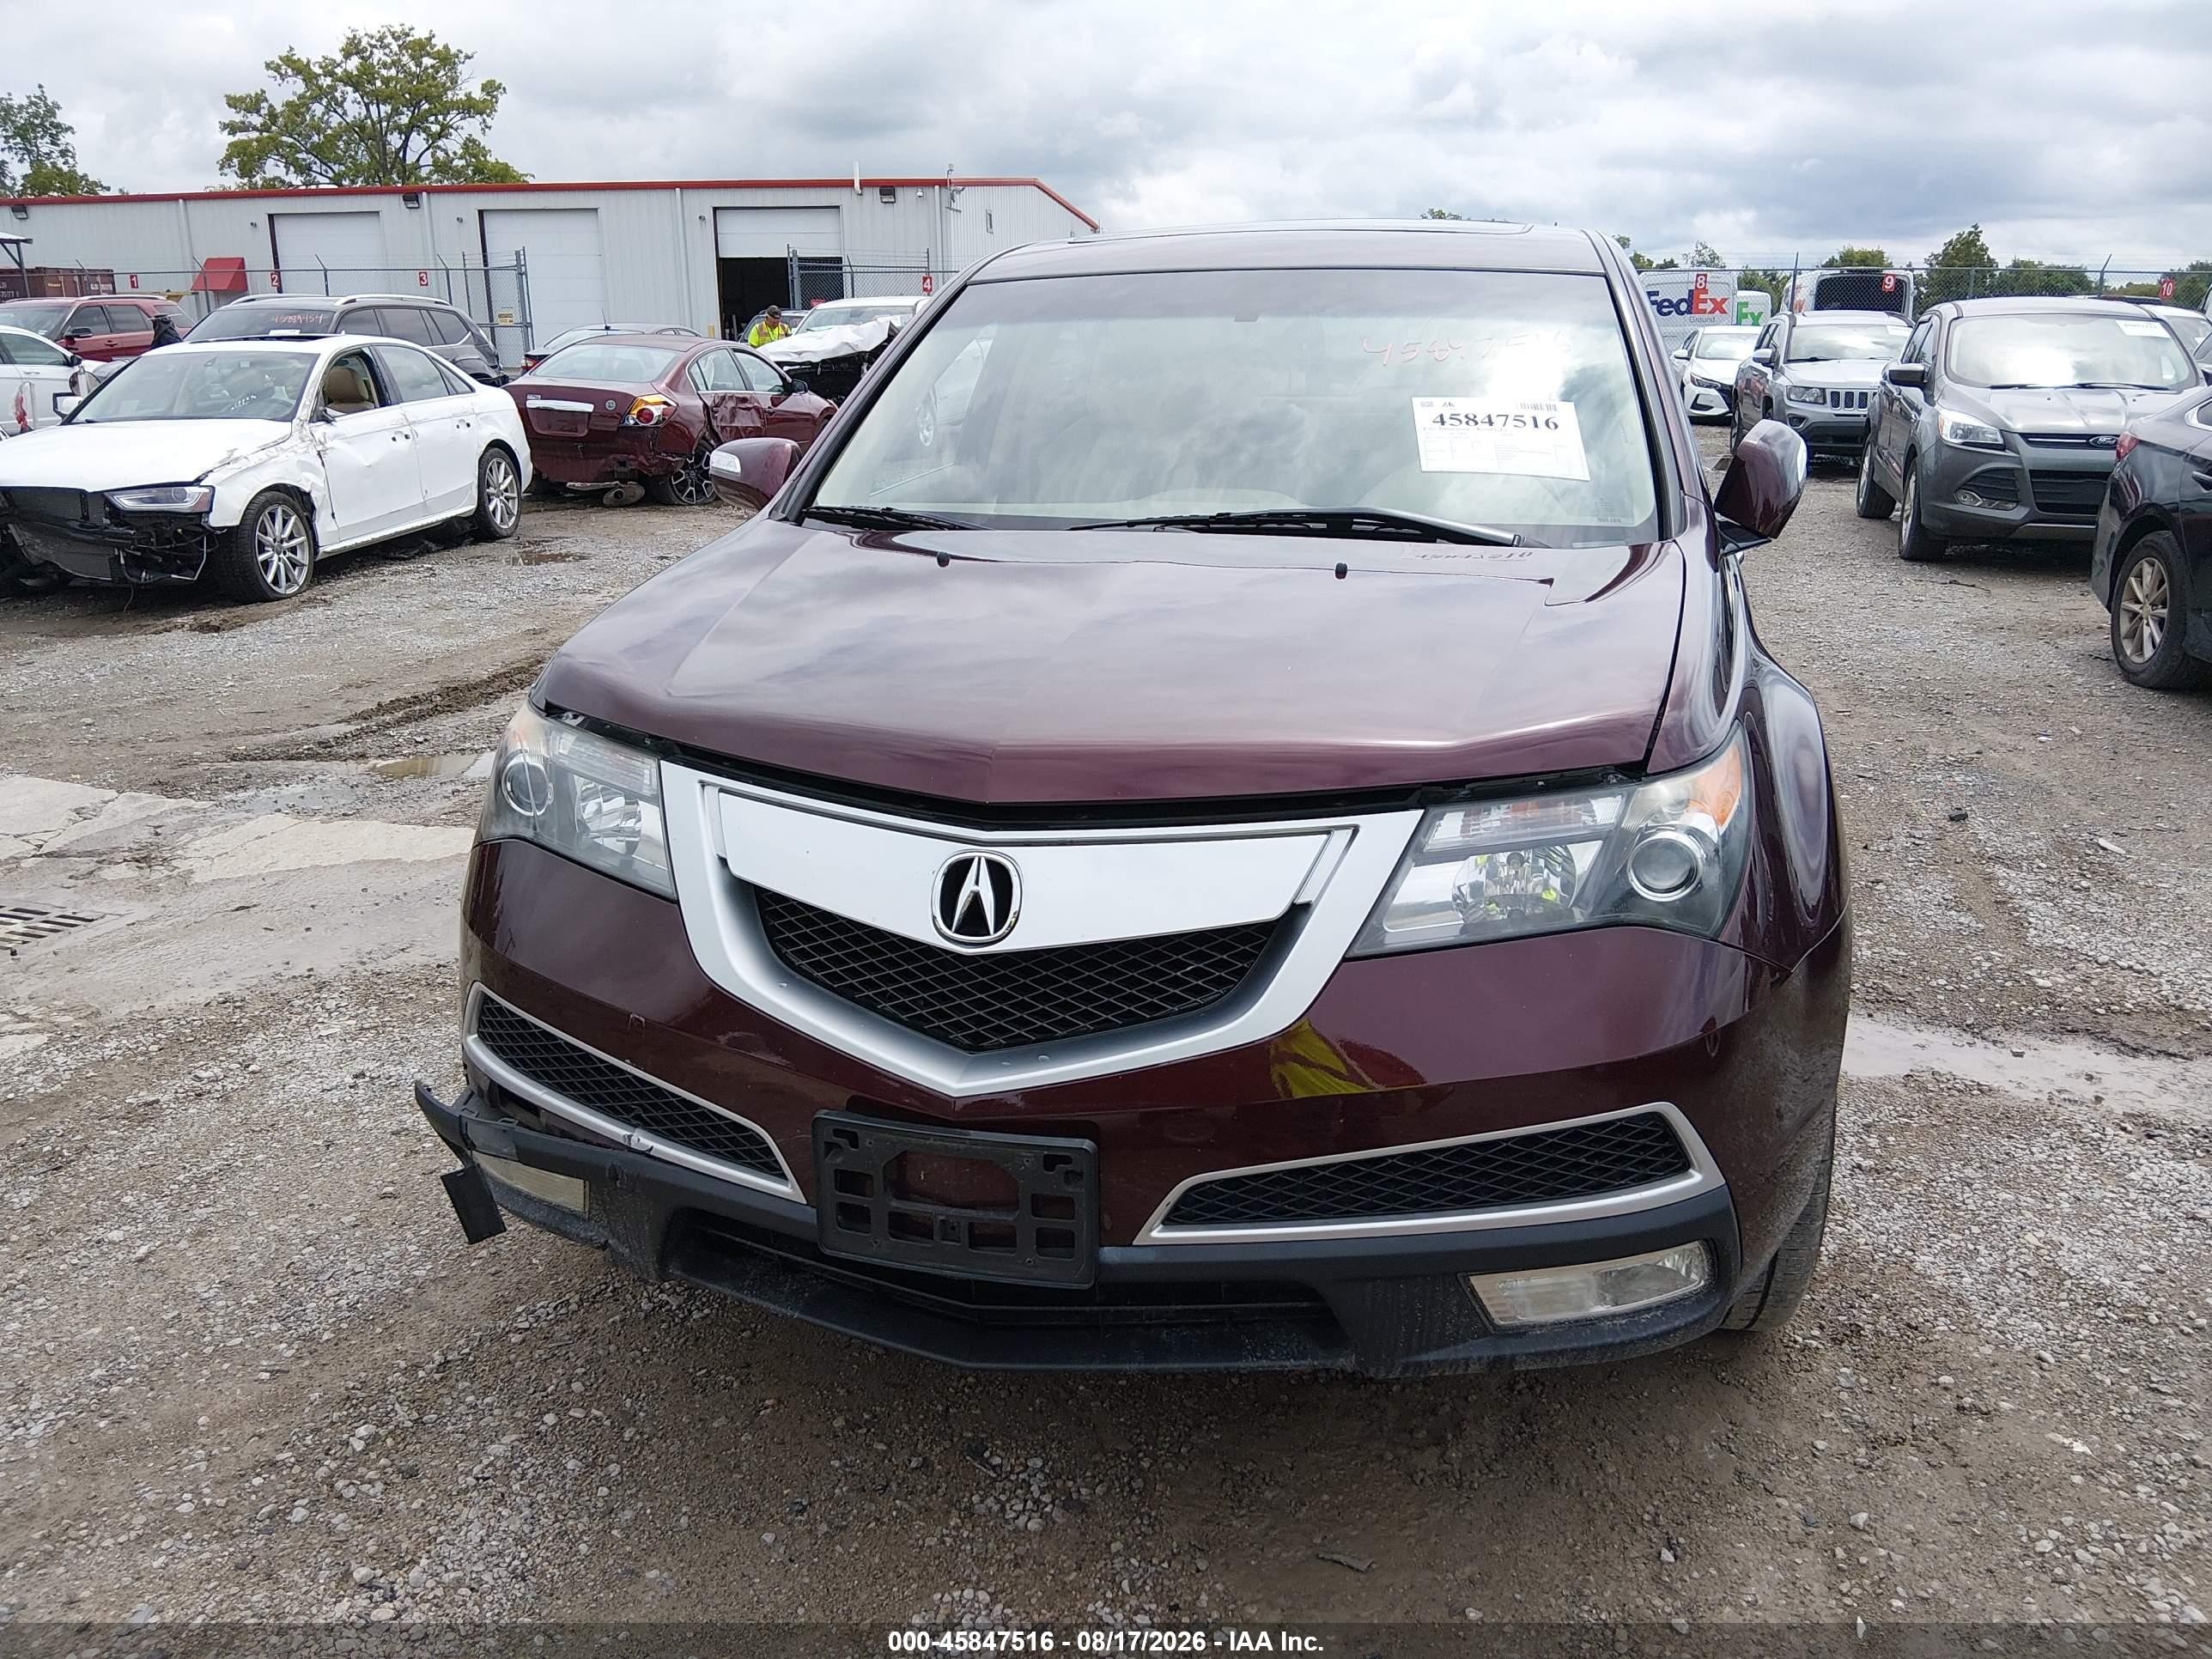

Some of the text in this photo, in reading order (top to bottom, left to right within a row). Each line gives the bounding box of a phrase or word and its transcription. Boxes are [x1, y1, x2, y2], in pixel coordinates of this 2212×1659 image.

[131, 276, 137, 288] 1
[271, 274, 279, 286] 2
[420, 273, 428, 285] 3
[923, 277, 932, 290] 4
[1696, 276, 1706, 289] 8
[1883, 275, 1894, 289] 9
[2162, 281, 2173, 296] 10
[1646, 289, 1729, 316] FedEx
[1689, 315, 1716, 324] Ground
[1431, 412, 1559, 430] 45847516
